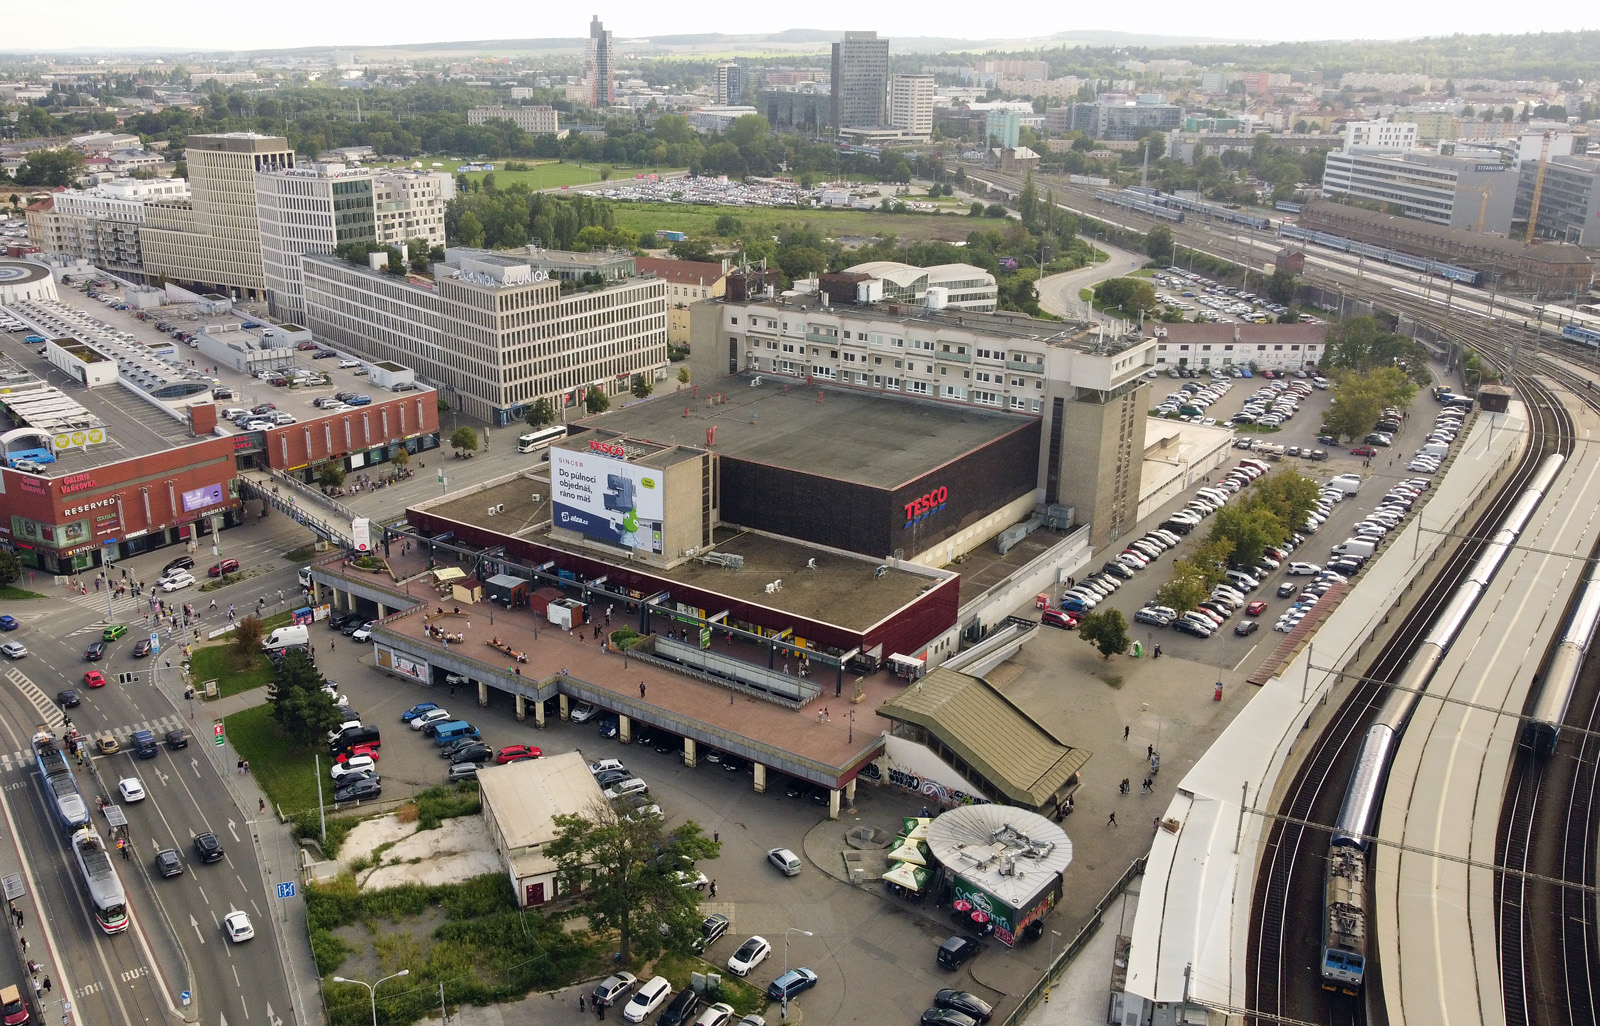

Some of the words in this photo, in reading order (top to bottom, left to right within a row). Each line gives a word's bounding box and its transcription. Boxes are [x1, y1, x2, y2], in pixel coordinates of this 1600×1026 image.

[473, 272, 495, 288] UNIQA
[517, 269, 550, 285] UNIQA
[588, 440, 624, 456] TESCO
[558, 458, 584, 467] SINGER
[559, 468, 570, 478] Do
[571, 471, 596, 483] půlnoci
[559, 480, 593, 495] objednáš,
[559, 490, 576, 500] ráno
[577, 493, 591, 503] máš
[904, 486, 948, 520] TESCO
[64, 497, 115, 517] RESERVED
[201, 507, 226, 517] BUSHMAN
[570, 516, 588, 525] alza.cz
[125, 529, 148, 539] HUMANIC
[72, 544, 96, 554] TRIPOLI
[4, 780, 28, 792] BUS
[120, 966, 150, 983] BUS
[75, 981, 104, 998] BUS
